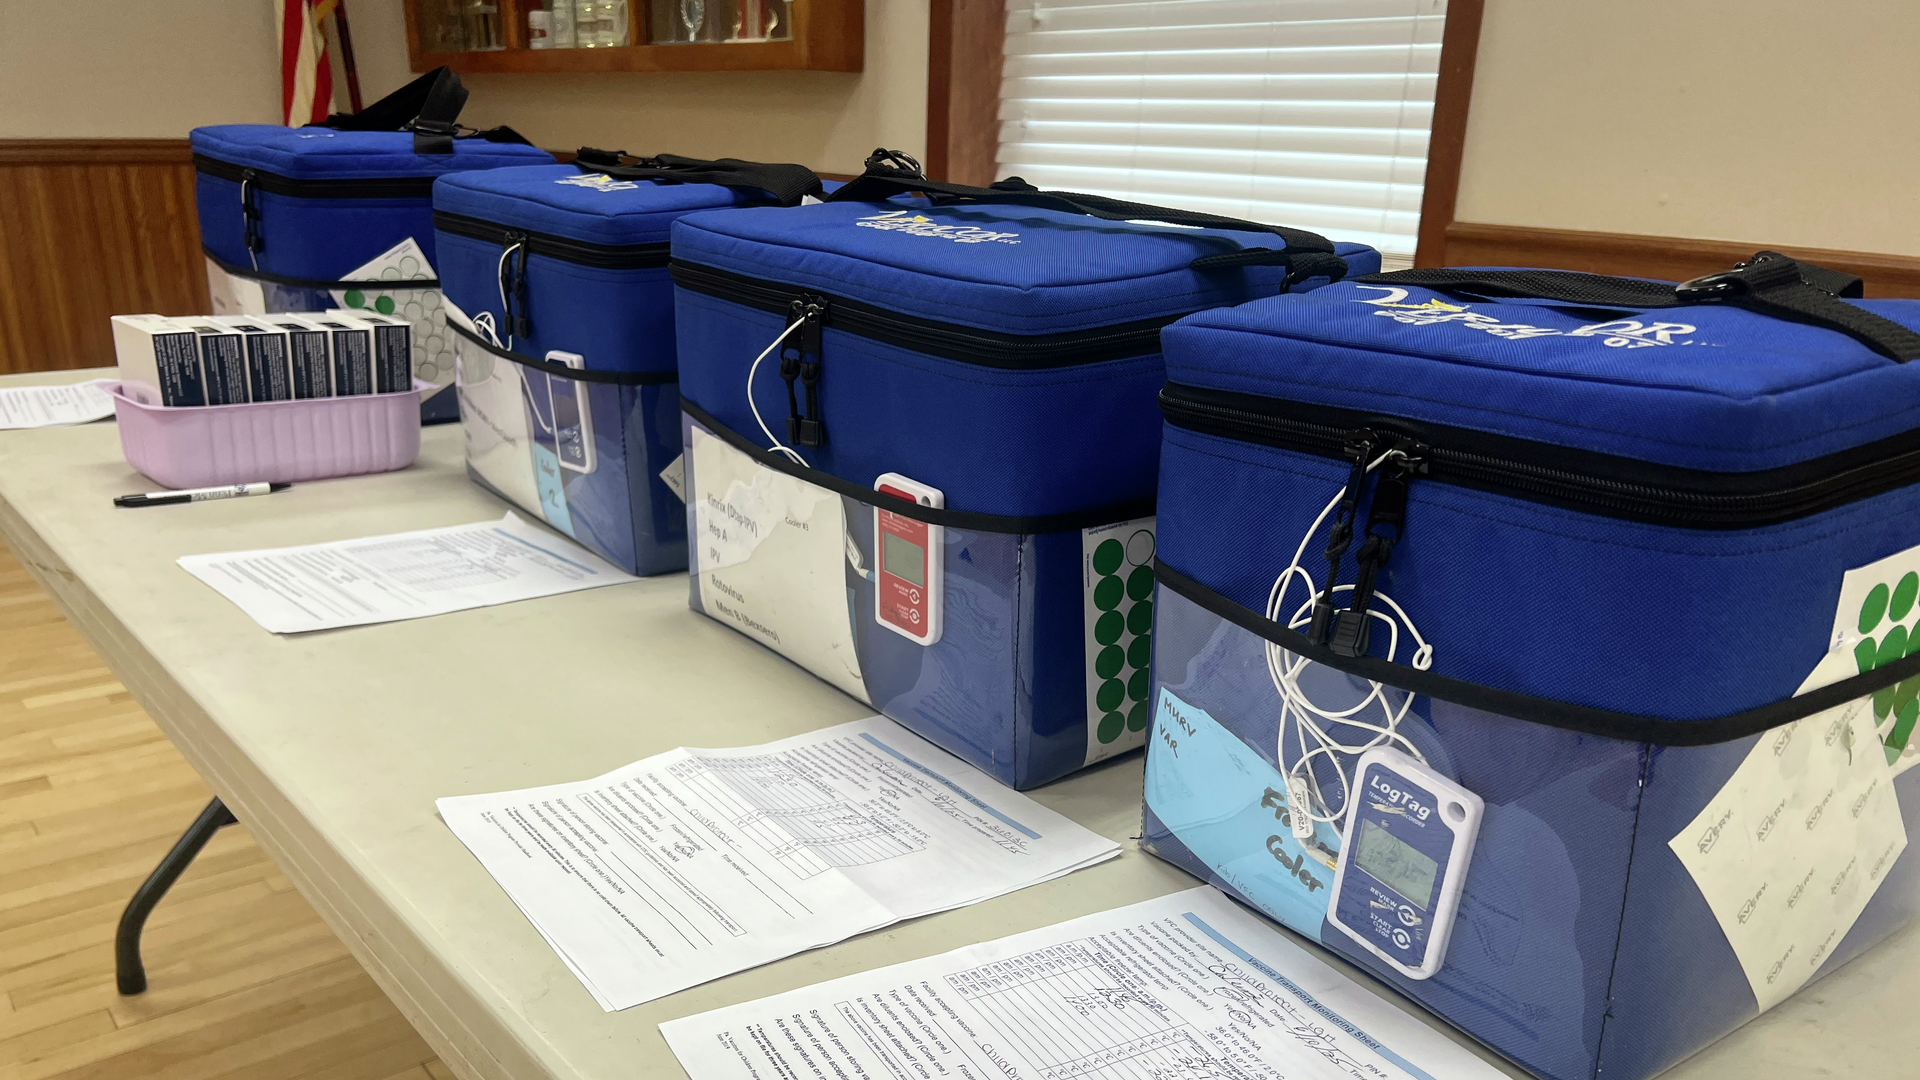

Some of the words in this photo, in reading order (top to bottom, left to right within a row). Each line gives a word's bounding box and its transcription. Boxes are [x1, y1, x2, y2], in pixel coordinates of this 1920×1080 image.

[708, 493, 726, 514] Kinrix
[785, 516, 801, 529] Cooler
[802, 522, 809, 531] #3
[709, 519, 720, 539] Hep
[722, 529, 727, 542] A
[711, 547, 720, 563] IPV
[716, 599, 733, 618] Men
[1160, 724, 1178, 758] VAR
[1370, 775, 1431, 821] LogTag
[1805, 789, 1835, 830] AVERY
[1697, 809, 1734, 854] AVERY
[1756, 799, 1787, 842] AVERY
[1266, 835, 1324, 892] Cooler
[1831, 856, 1857, 895] AVERY
[1370, 887, 1397, 908] REVIEW
[1737, 882, 1768, 924] AVERY
[1787, 868, 1816, 908] AVERY
[1370, 913, 1392, 930] START
[1372, 921, 1390, 934] CLEAR
[1375, 927, 1389, 938] STOP
[1084, 936, 1115, 959] Acceptable
[1110, 958, 1134, 974] freezer
[1098, 934, 1126, 956] Acceptable
[1125, 956, 1155, 978] refrigerator
[1132, 935, 1153, 951] diluents
[1151, 951, 1181, 971] enclosed?
[1177, 971, 1198, 985] (Circle
[1137, 924, 1151, 935] Type
[1155, 939, 1176, 955] vaccine
[1173, 954, 1193, 968] (Circle
[1767, 944, 1795, 984] AVERY
[1810, 929, 1836, 965] AVERY
[903, 984, 917, 996] Date
[1094, 951, 1108, 963] Time
[1105, 963, 1126, 979] (Circle
[1124, 979, 1139, 990] one:
[1150, 920, 1173, 939] Vaccine
[1171, 938, 1191, 952] packed
[1269, 1008, 1285, 1021] Date:
[919, 980, 937, 997] Facility
[934, 997, 958, 1019] accepting
[1077, 995, 1096, 1009] 1330
[1115, 935, 1138, 954] inventory
[1137, 953, 1154, 966] sheet
[1151, 966, 1180, 985] attached?
[1177, 985, 1197, 999] (Circle
[1228, 1022, 1261, 1051] Yes/No/NA
[1163, 917, 1177, 927] VFC
[1173, 927, 1197, 943] provider
[1195, 943, 1207, 951] site
[1364, 1064, 1381, 1075] PIN
[1248, 957, 1276, 976] Vaccine
[1273, 976, 1315, 1003] Transport
[1310, 1002, 1354, 1033] Monitoring
[1354, 1031, 1380, 1049] Sheet
[792, 1013, 813, 1037] Signature
[812, 1043, 832, 1060] person
[809, 1009, 830, 1032] Signature
[830, 1038, 849, 1056] person
[846, 1055, 864, 1073] storing
[847, 1013, 858, 1023] above
[856, 1023, 868, 1036] vaccine
[871, 1041, 881, 1051] been
[879, 1050, 899, 1070] transported
[860, 1002, 881, 1024] inventory
[878, 1023, 895, 1038] sheet
[890, 1037, 917, 1061] attached?
[911, 1062, 930, 1079] (Circle
[872, 993, 882, 1002] Are
[879, 1002, 898, 1021] diluents
[896, 1020, 922, 1044] enclosed?
[916, 1044, 935, 1061] (Circle
[933, 1061, 949, 1075] one.)
[888, 988, 901, 1001] Type
[904, 1006, 923, 1024] vaccine
[918, 1024, 937, 1040] (Circle
[935, 1040, 951, 1054] one.)
[749, 1030, 758, 1039] kept
[768, 1056, 777, 1066] three
[773, 1066, 785, 1077] years
[757, 1027, 776, 1052] Temperatures
[774, 1051, 787, 1065] should
[774, 1018, 785, 1028] Are
[781, 1027, 795, 1042] these
[792, 1042, 816, 1068] signatures
